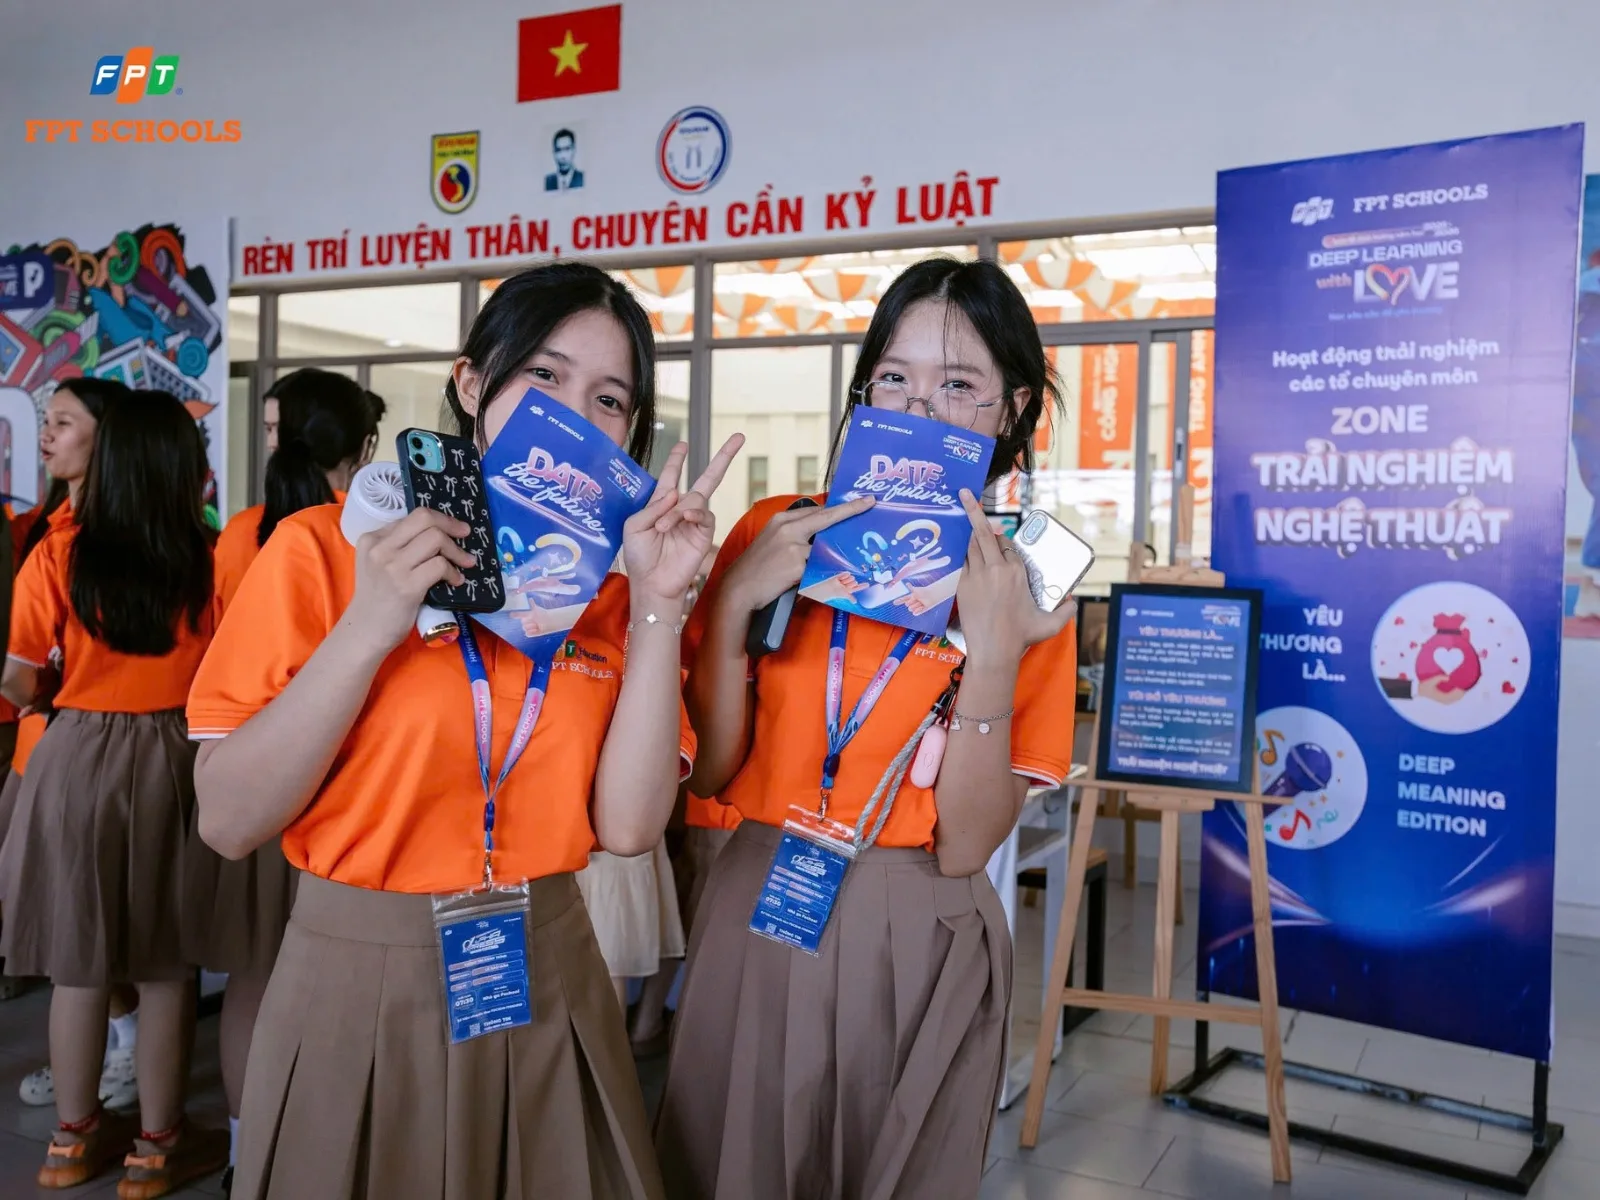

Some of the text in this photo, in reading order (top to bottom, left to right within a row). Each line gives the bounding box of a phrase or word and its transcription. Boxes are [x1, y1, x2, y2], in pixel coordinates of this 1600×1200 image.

[1353, 194, 1389, 213] FPT
[1392, 184, 1489, 209] SCHOOLS
[243, 170, 1000, 276] RÈN TRÍ LUYỆN THÂN, CHUYÊN CẦN KỶ LUẬT
[1308, 239, 1463, 269] DEEP LEARNING
[1316, 272, 1352, 289] with
[1272, 338, 1500, 370] Hoạt động trải nghiệm
[1289, 367, 1478, 392] các tổ chuyên môn
[1331, 404, 1429, 435] ZONE
[527, 446, 604, 509] DATE
[870, 454, 946, 489] DATE
[1252, 438, 1340, 488] TRẢI
[1346, 437, 1514, 496] NGHIỆM
[503, 462, 605, 532] the future
[853, 472, 957, 506] the future
[1255, 497, 1512, 555] NGHỆ THUẬT
[1303, 604, 1343, 627] YÊU
[914, 647, 936, 660] FPT
[1259, 633, 1342, 654] THƯƠNG
[832, 660, 840, 686] SCHOOL
[1302, 660, 1346, 682] LÀ...
[864, 679, 881, 704] SCHOOL
[480, 710, 488, 745] SCHOOL
[521, 703, 537, 734] SCHOOL
[1398, 753, 1455, 775] DEEP
[1397, 781, 1506, 810] MEANING
[1397, 809, 1487, 838] EDITION
